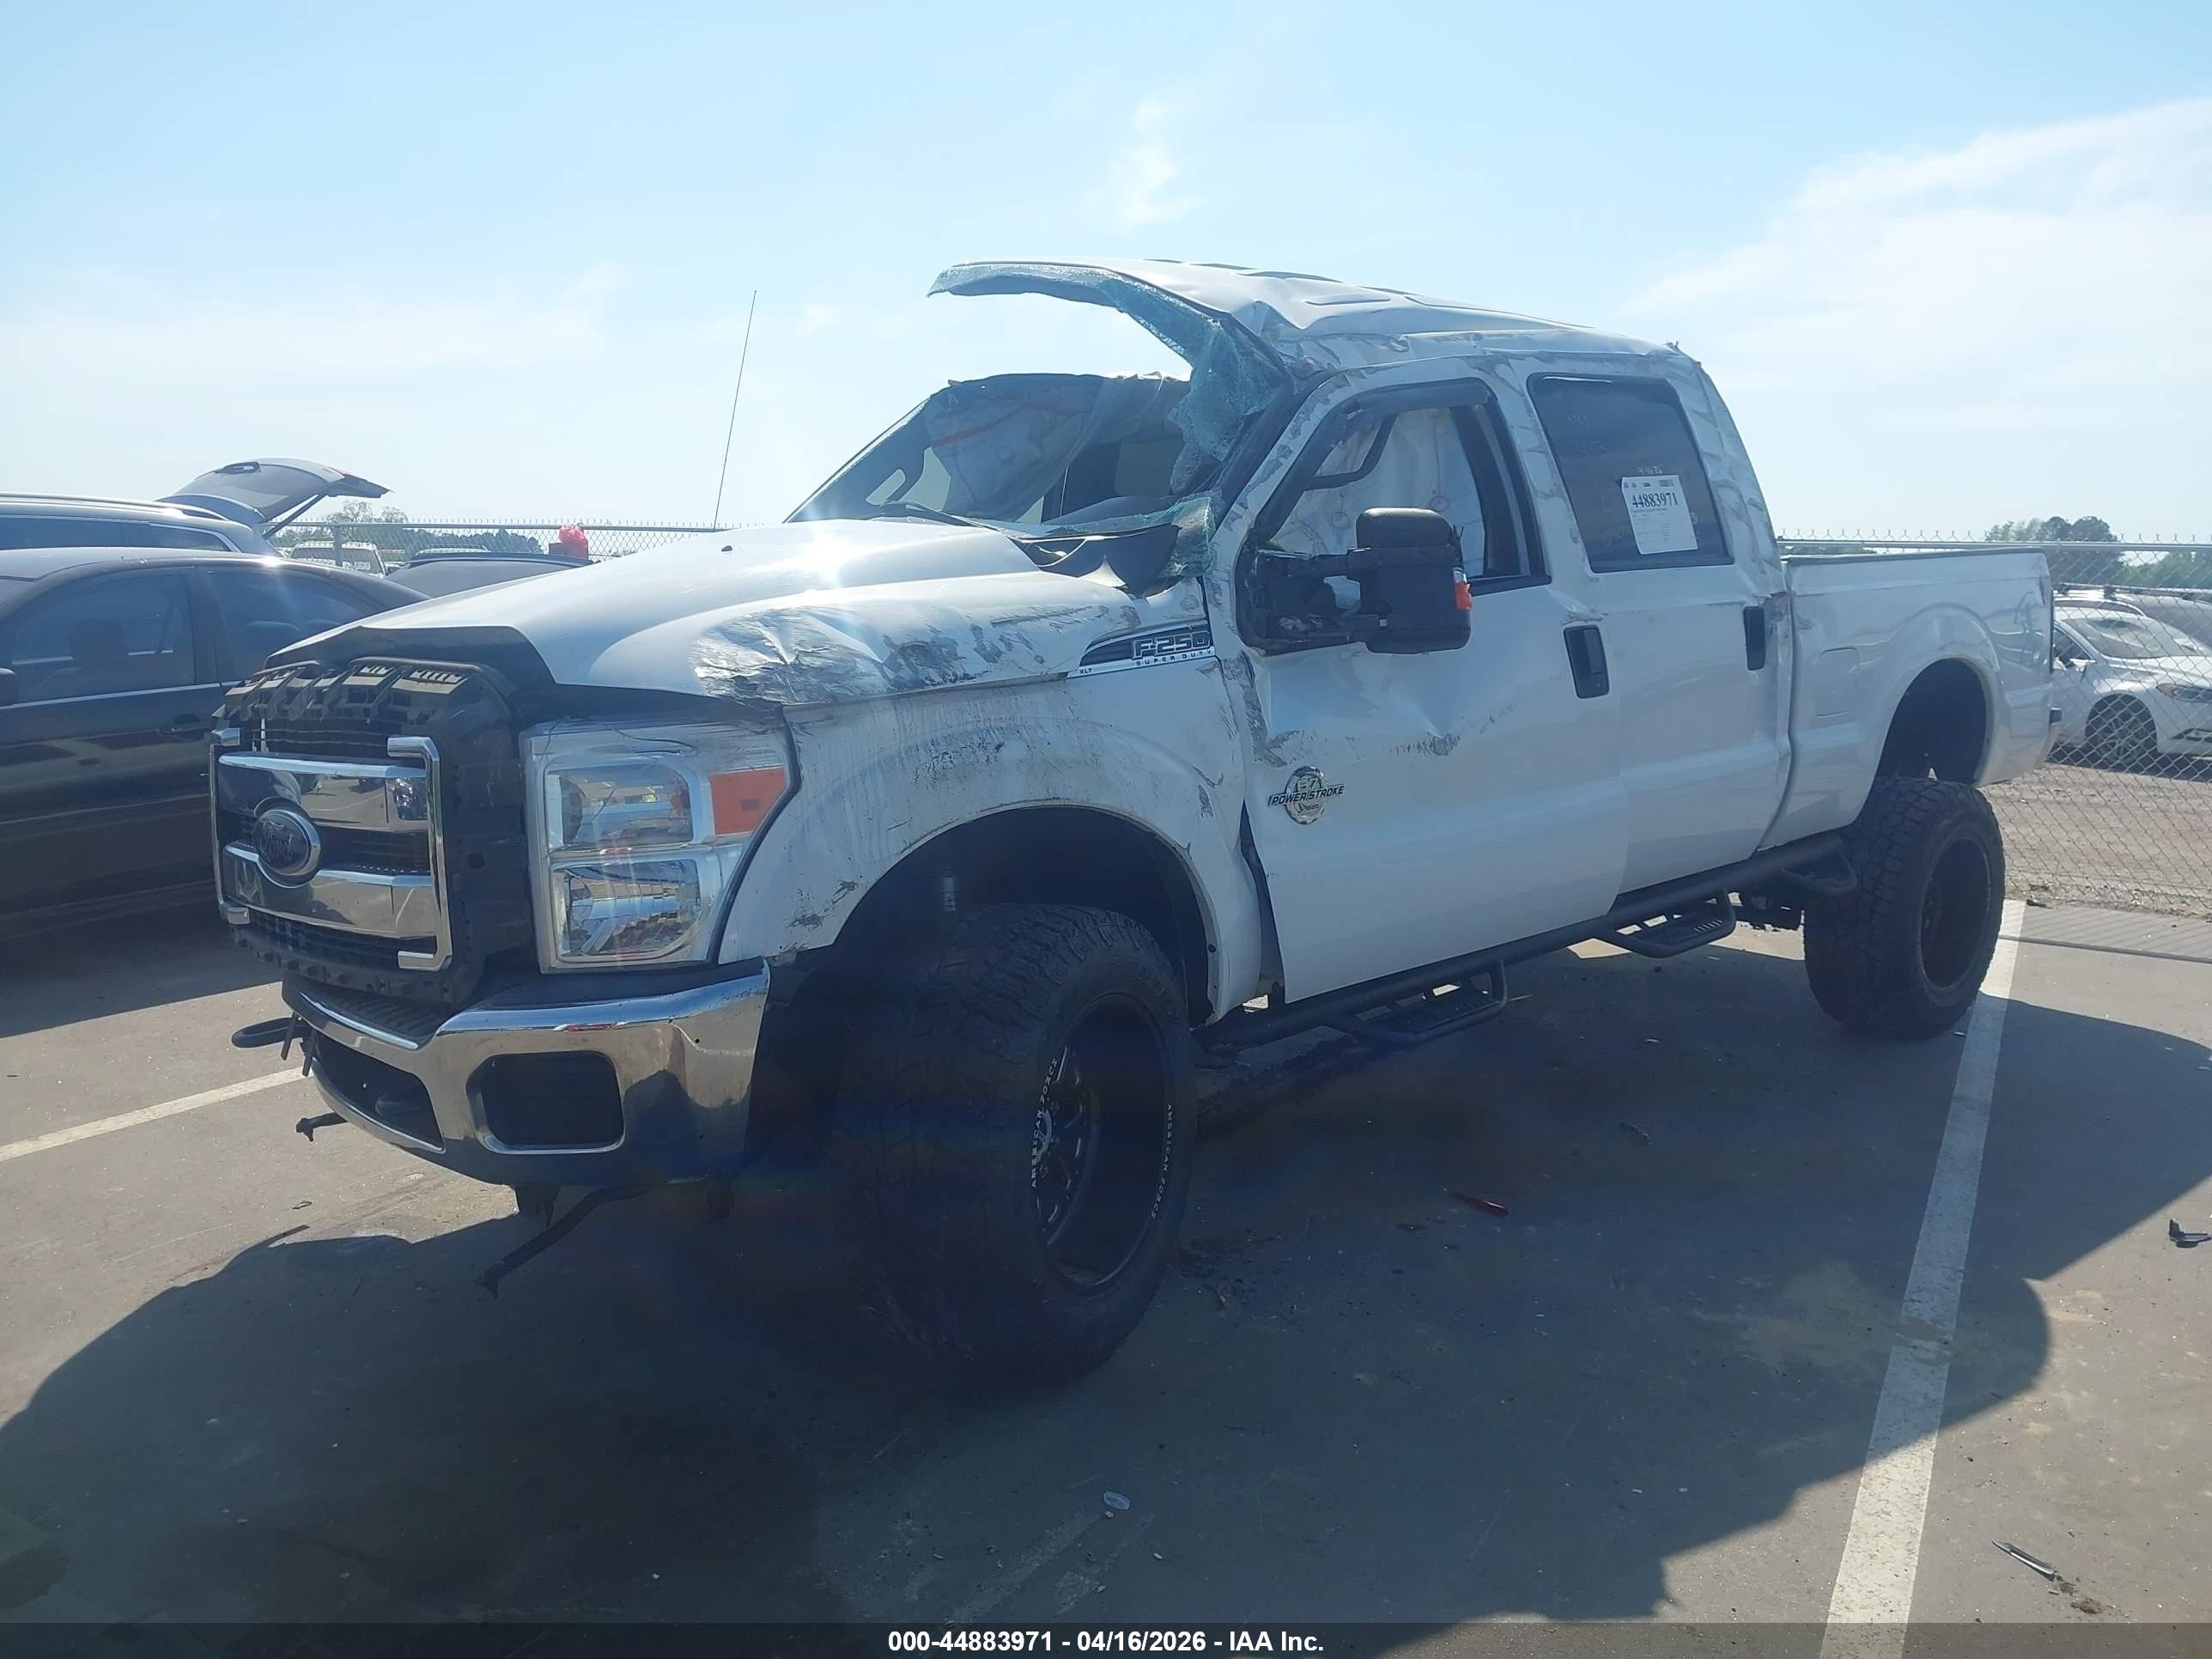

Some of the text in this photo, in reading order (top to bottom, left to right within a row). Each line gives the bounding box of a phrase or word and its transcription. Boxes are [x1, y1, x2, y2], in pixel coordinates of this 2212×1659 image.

[1632, 492, 1679, 507] 44883971
[1135, 649, 1213, 666] SUPER DUTY
